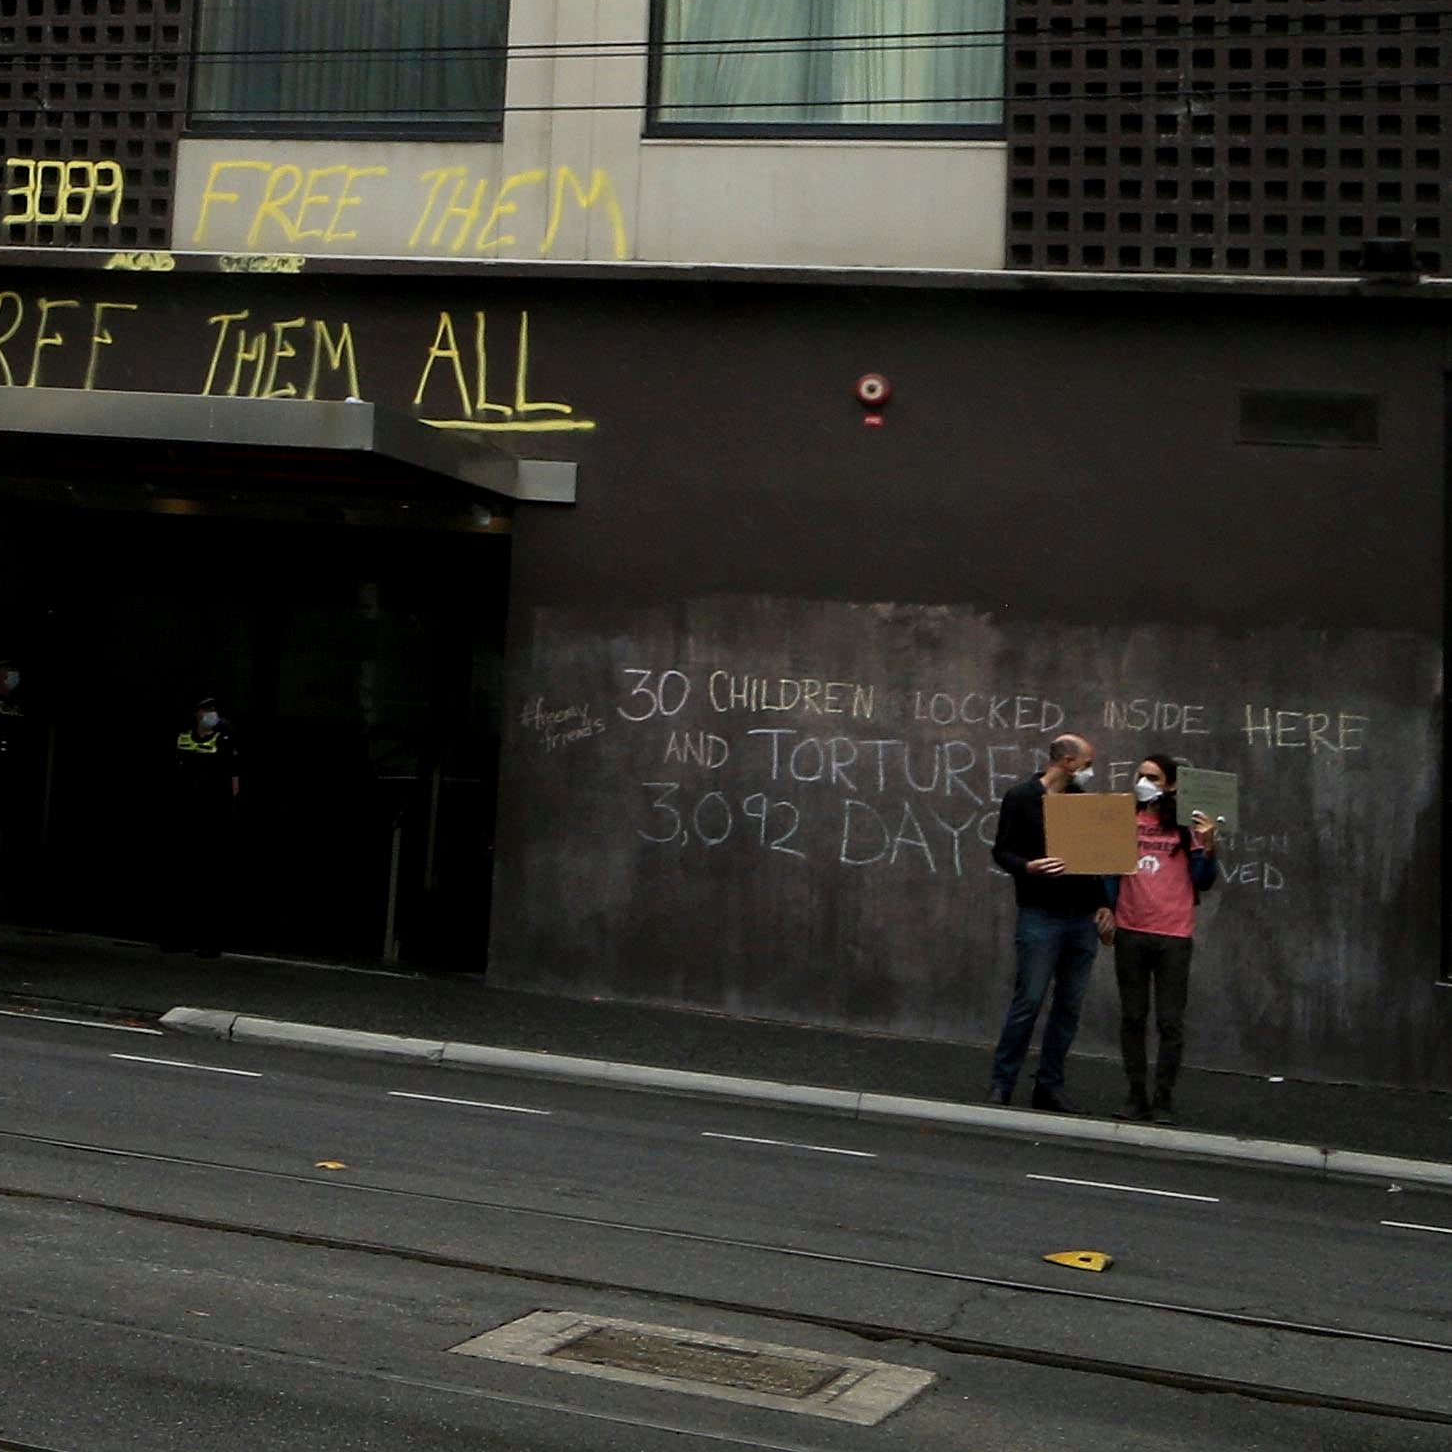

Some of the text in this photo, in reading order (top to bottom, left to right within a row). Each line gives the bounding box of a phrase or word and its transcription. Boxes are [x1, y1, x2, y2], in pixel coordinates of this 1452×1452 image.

[3, 157, 124, 226] 3089
[193, 160, 627, 261] FREE THEM
[202, 308, 362, 401] THEM
[413, 308, 573, 418] ALL
[616, 668, 1371, 755] 30 CHILDREN LOCKED INSIDE HERE
[663, 731, 730, 769] AND
